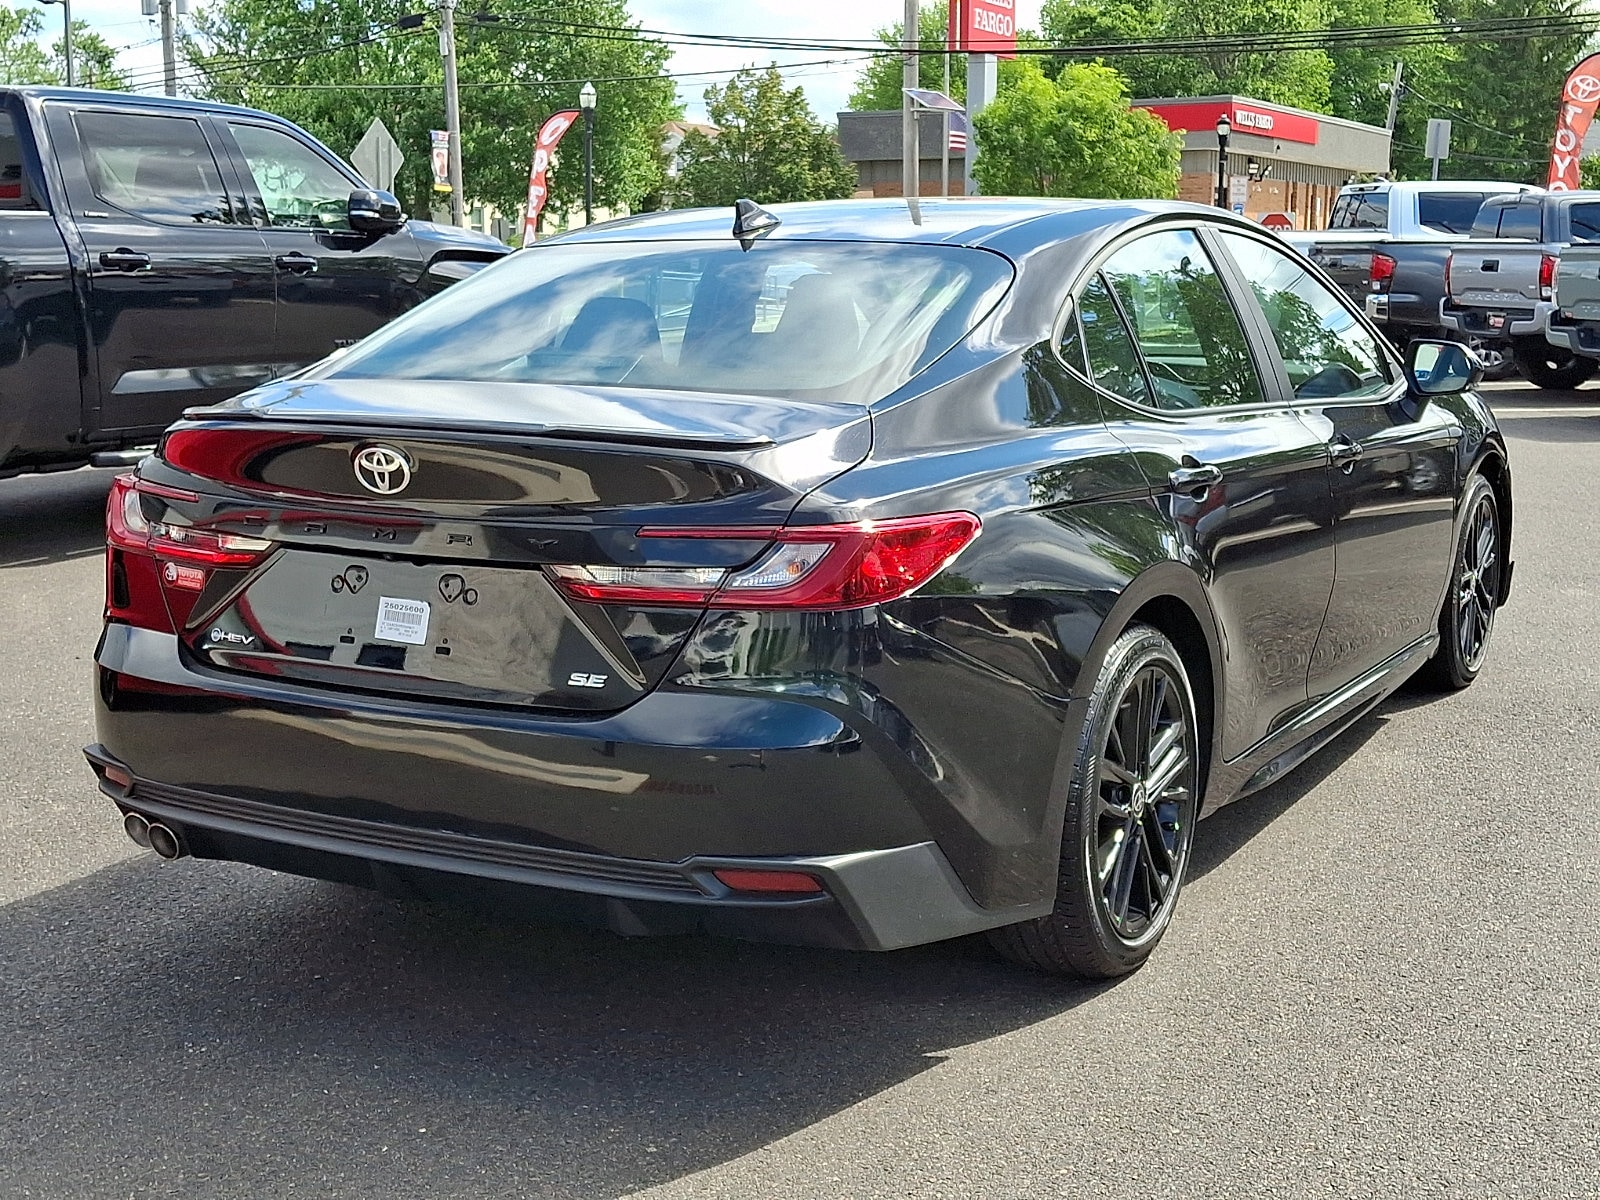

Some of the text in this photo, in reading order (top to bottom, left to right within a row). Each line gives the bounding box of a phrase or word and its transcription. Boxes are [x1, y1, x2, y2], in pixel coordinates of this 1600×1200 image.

[974, 8, 1012, 37] FARGO
[243, 514, 560, 550] CAMRY
[567, 672, 609, 688] SE
